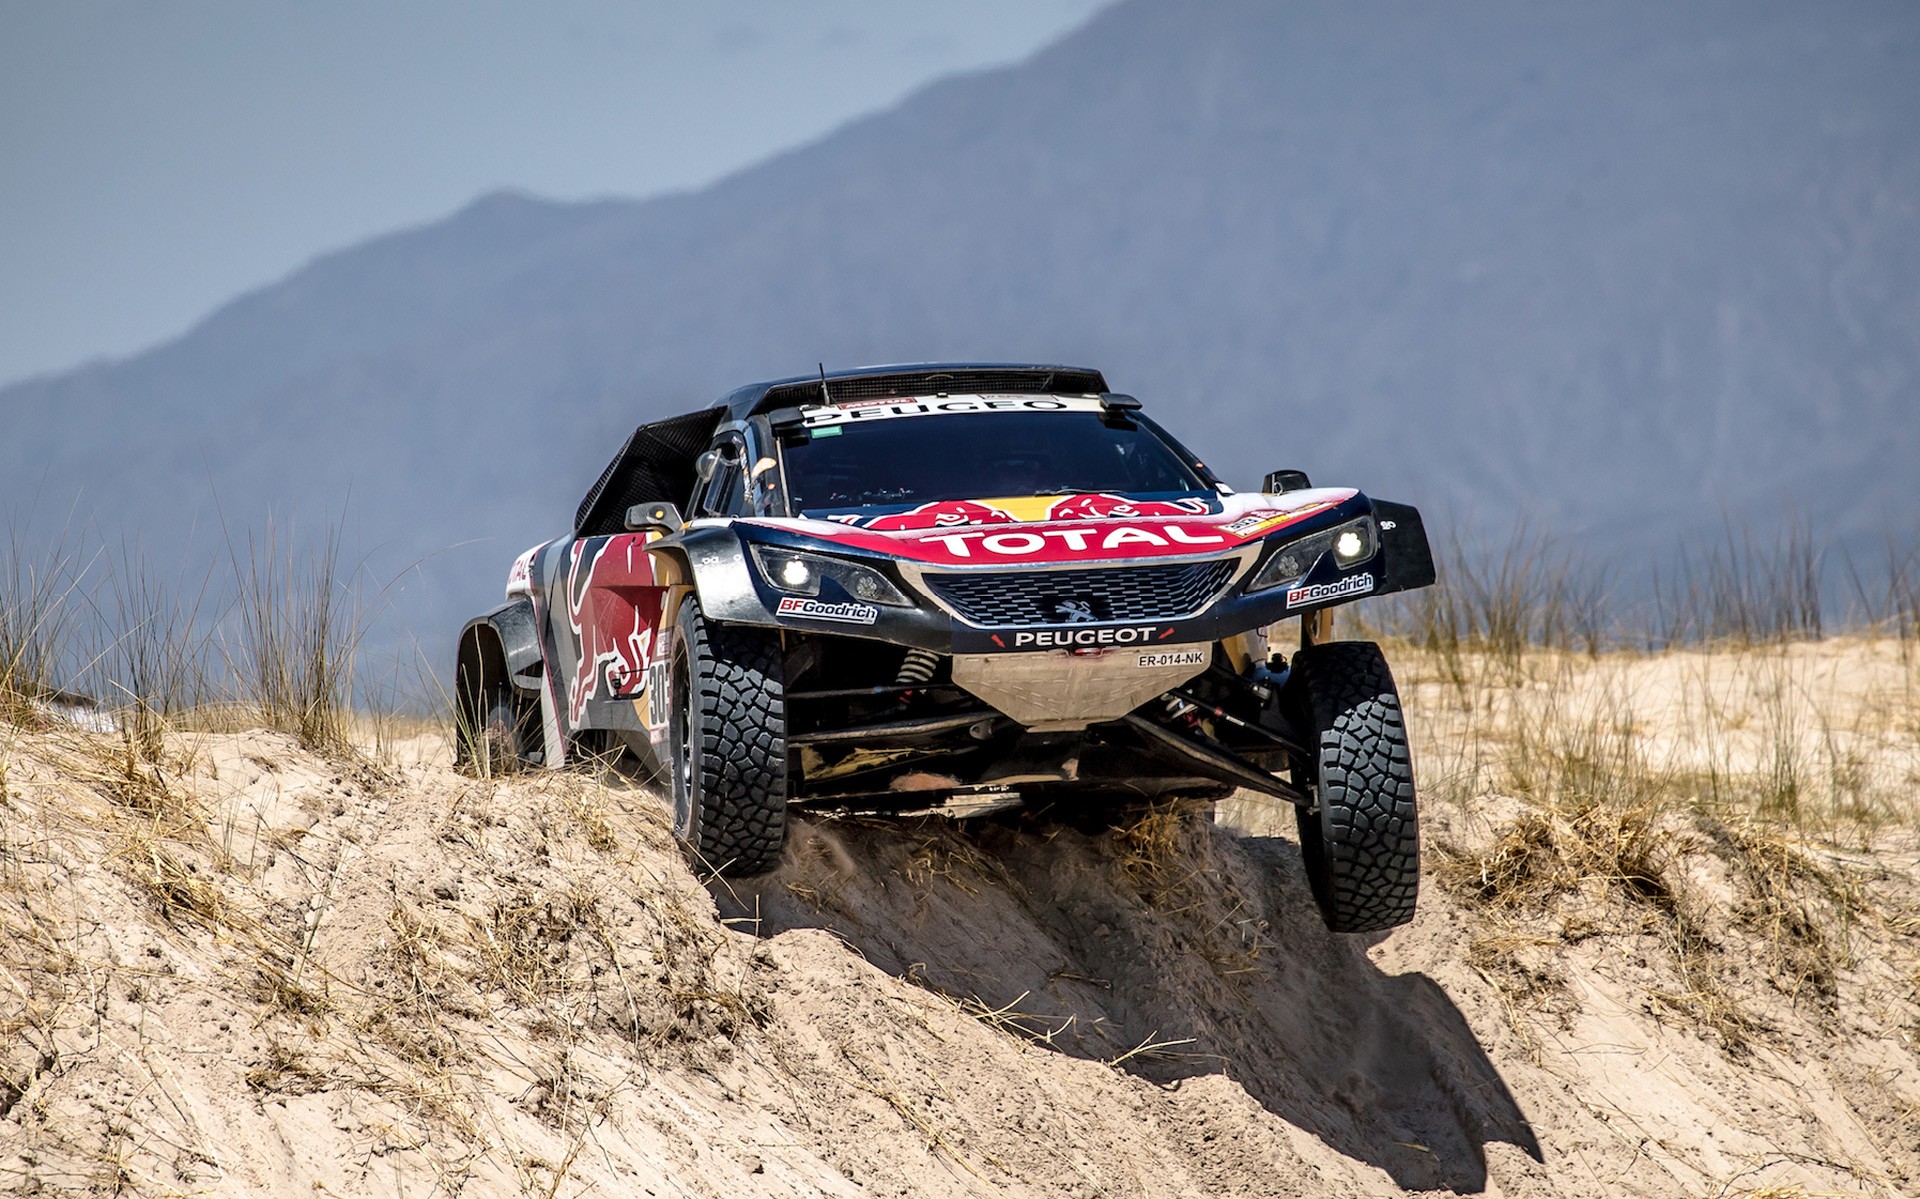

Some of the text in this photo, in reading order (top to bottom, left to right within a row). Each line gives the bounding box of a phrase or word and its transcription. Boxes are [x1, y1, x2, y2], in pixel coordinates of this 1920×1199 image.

[806, 400, 1068, 424] PEUGEO
[919, 525, 1224, 557] TOTAL
[1289, 575, 1372, 602] BFGoodrich
[780, 599, 875, 618] BFGoodrich
[1015, 627, 1157, 647] PEUGEOT
[1138, 652, 1203, 667] ER-014-NK
